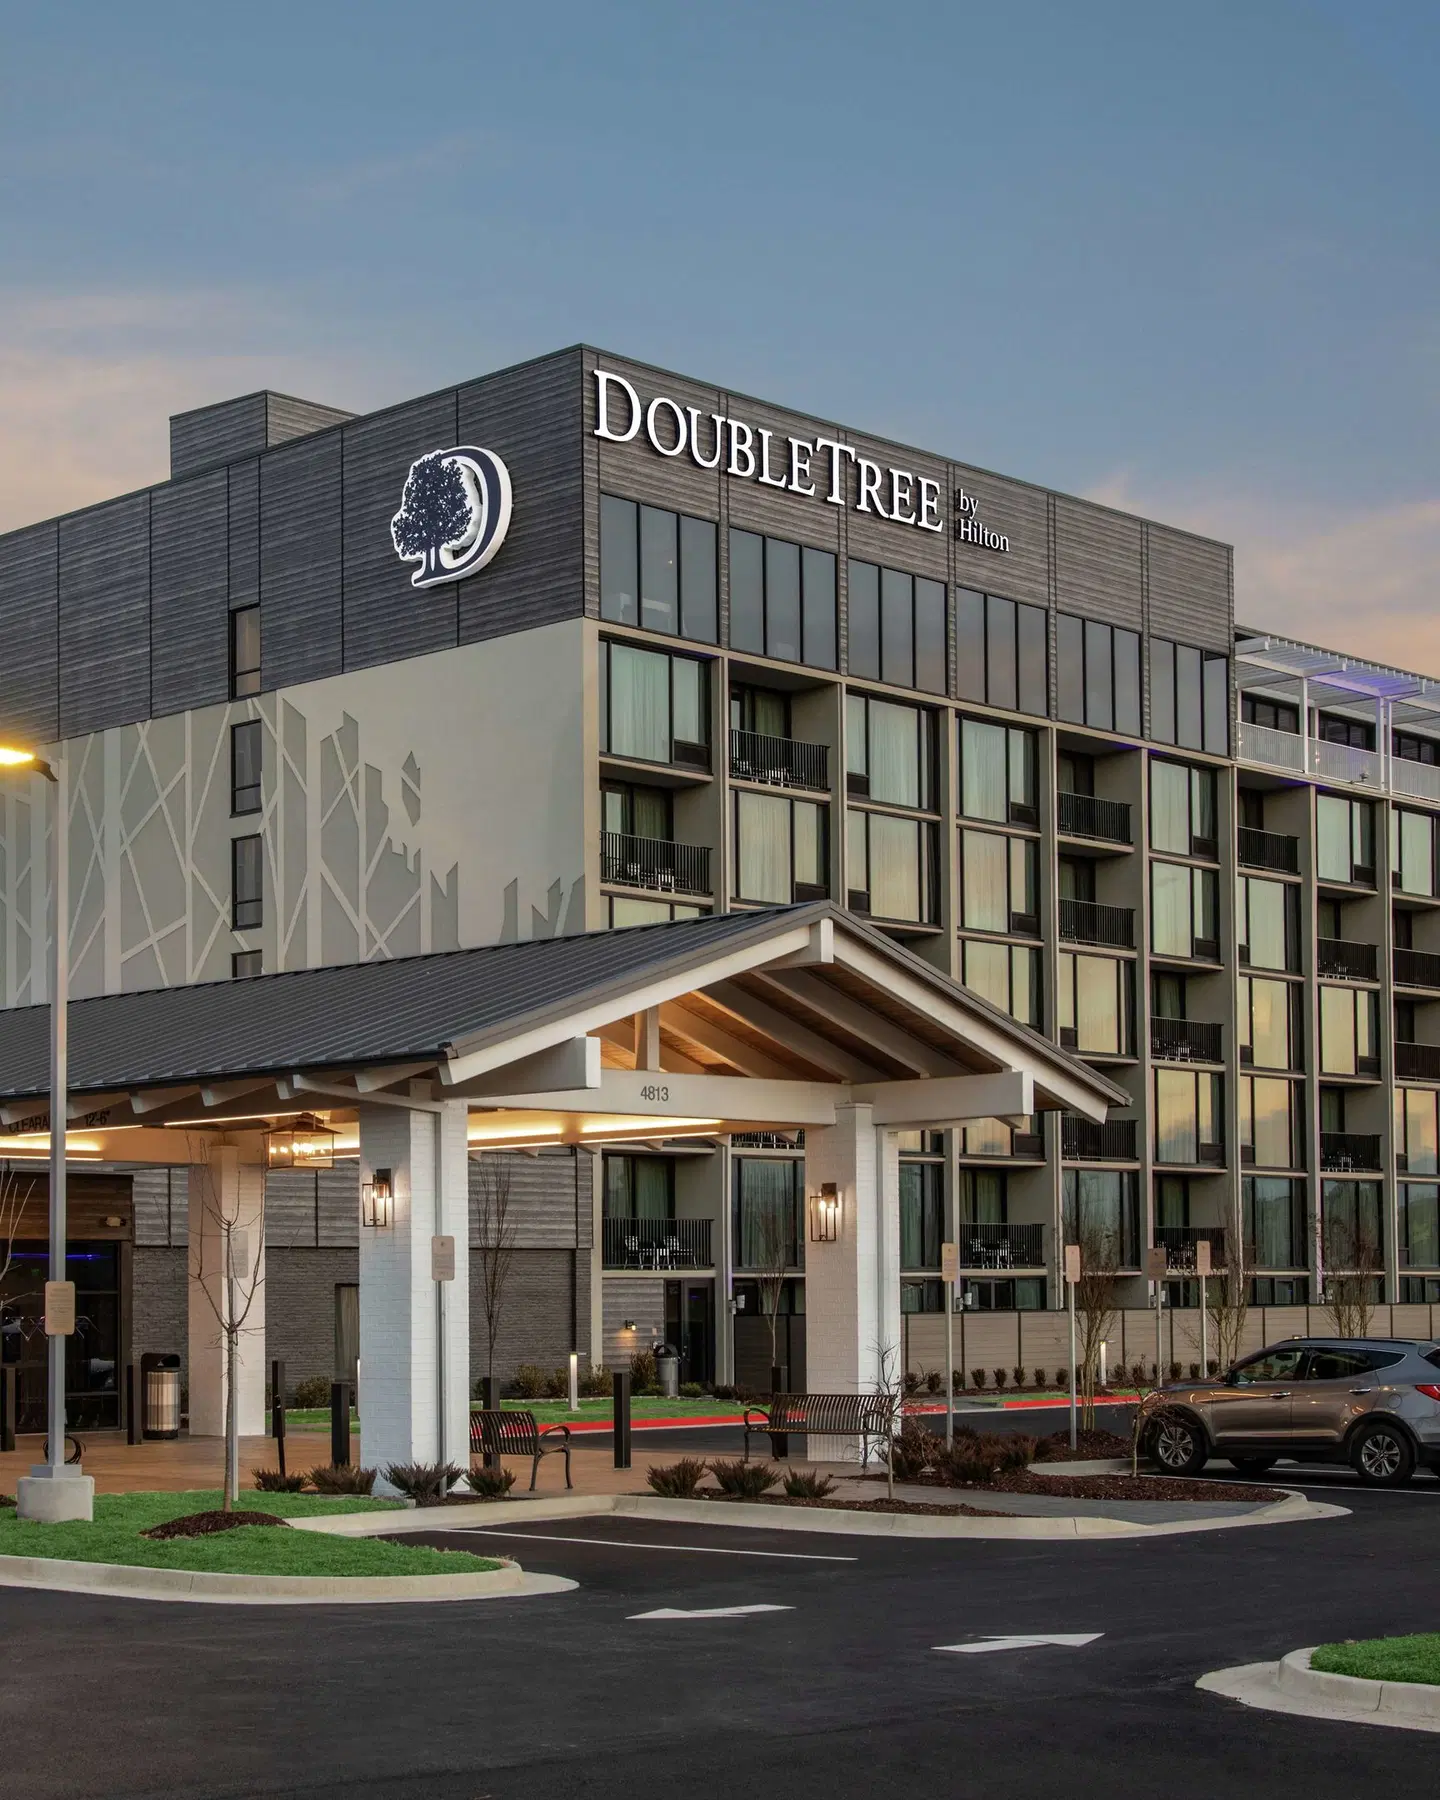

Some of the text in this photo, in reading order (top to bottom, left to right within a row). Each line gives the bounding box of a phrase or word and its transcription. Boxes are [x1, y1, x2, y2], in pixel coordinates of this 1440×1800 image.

[592, 369, 943, 533] DOUBLETREE
[960, 488, 979, 520] by
[960, 518, 1010, 552] Hilton
[640, 1085, 669, 1101] 4813
[8, 1116, 69, 1133] CLEARA
